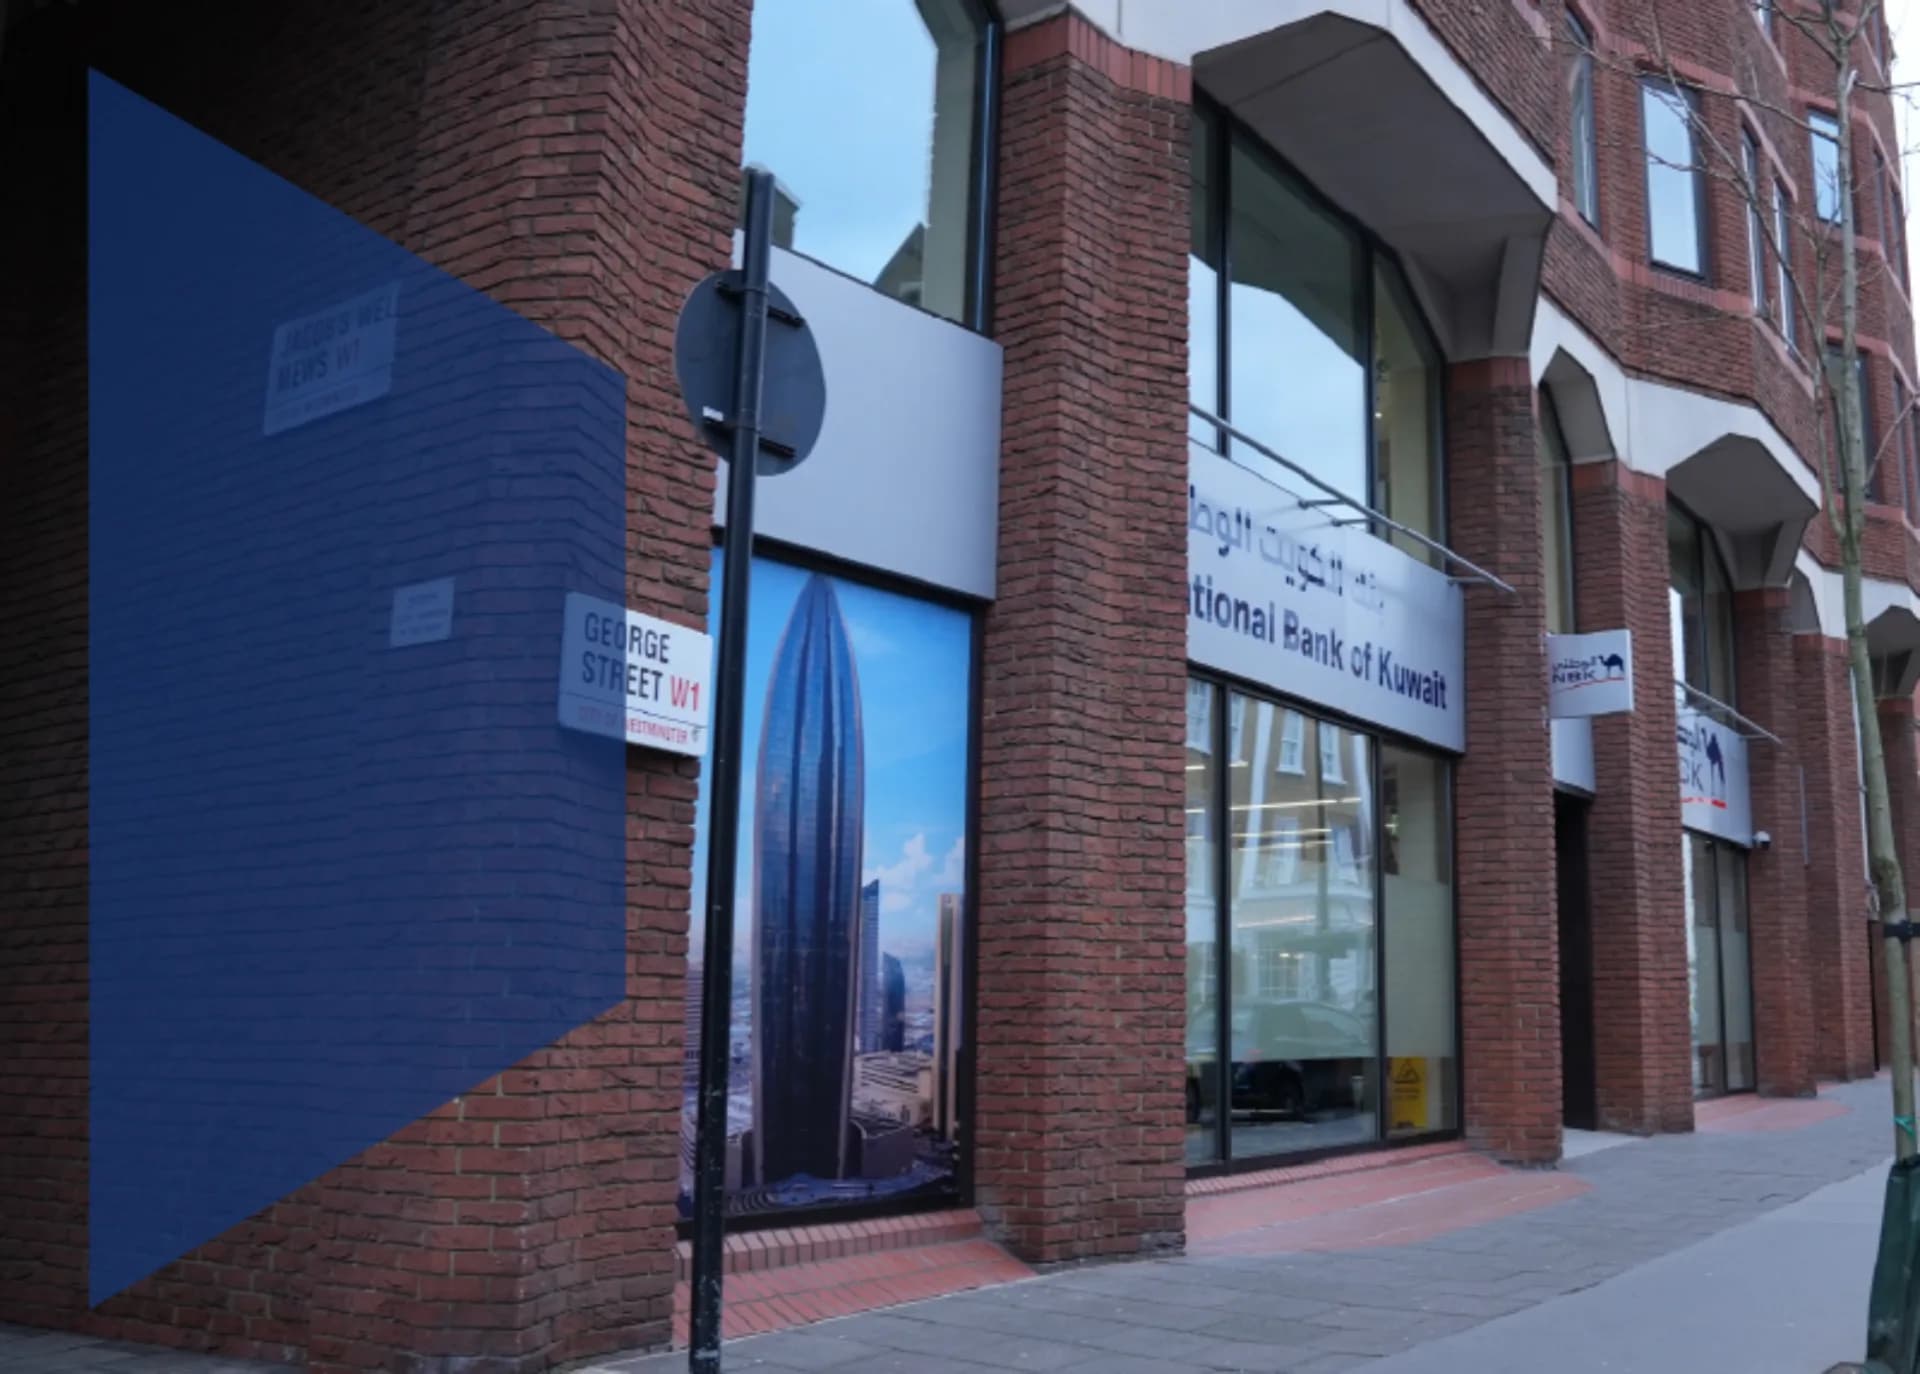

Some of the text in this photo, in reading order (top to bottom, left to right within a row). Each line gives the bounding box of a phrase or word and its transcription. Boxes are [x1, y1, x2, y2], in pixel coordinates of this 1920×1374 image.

[335, 336, 360, 373] W1
[584, 611, 671, 664] GEORGE
[1188, 573, 1448, 709] tional Bank of Kuwait
[581, 650, 701, 711] STREET W1
